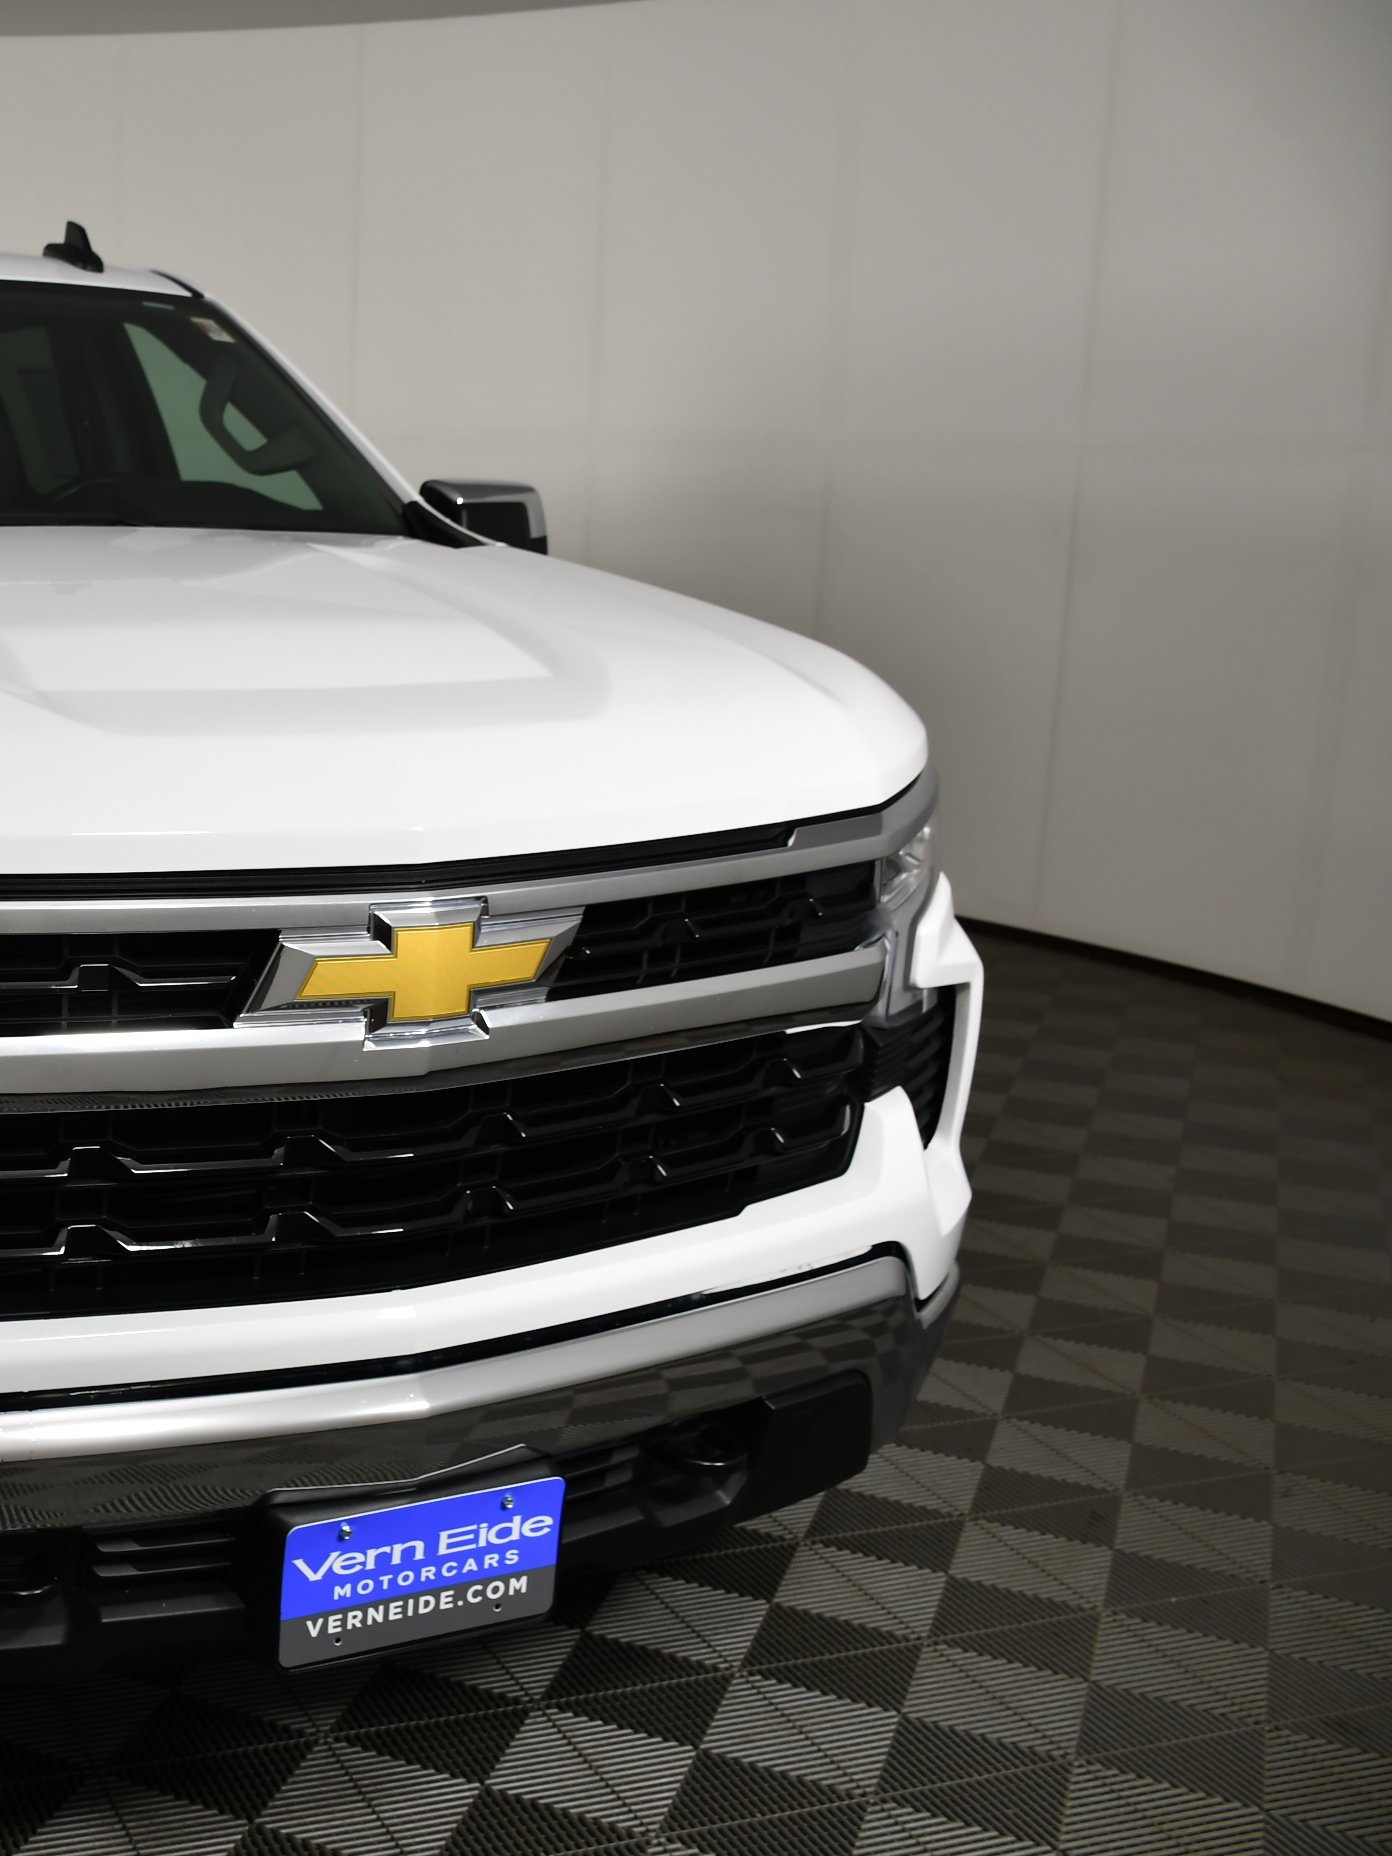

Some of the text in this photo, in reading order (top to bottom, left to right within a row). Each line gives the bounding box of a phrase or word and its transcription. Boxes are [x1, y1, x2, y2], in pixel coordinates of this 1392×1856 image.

[292, 1514, 553, 1582] Vern Eide
[333, 1549, 520, 1600] MOTORCARS
[306, 1575, 529, 1638] VERNEIDE.COM
